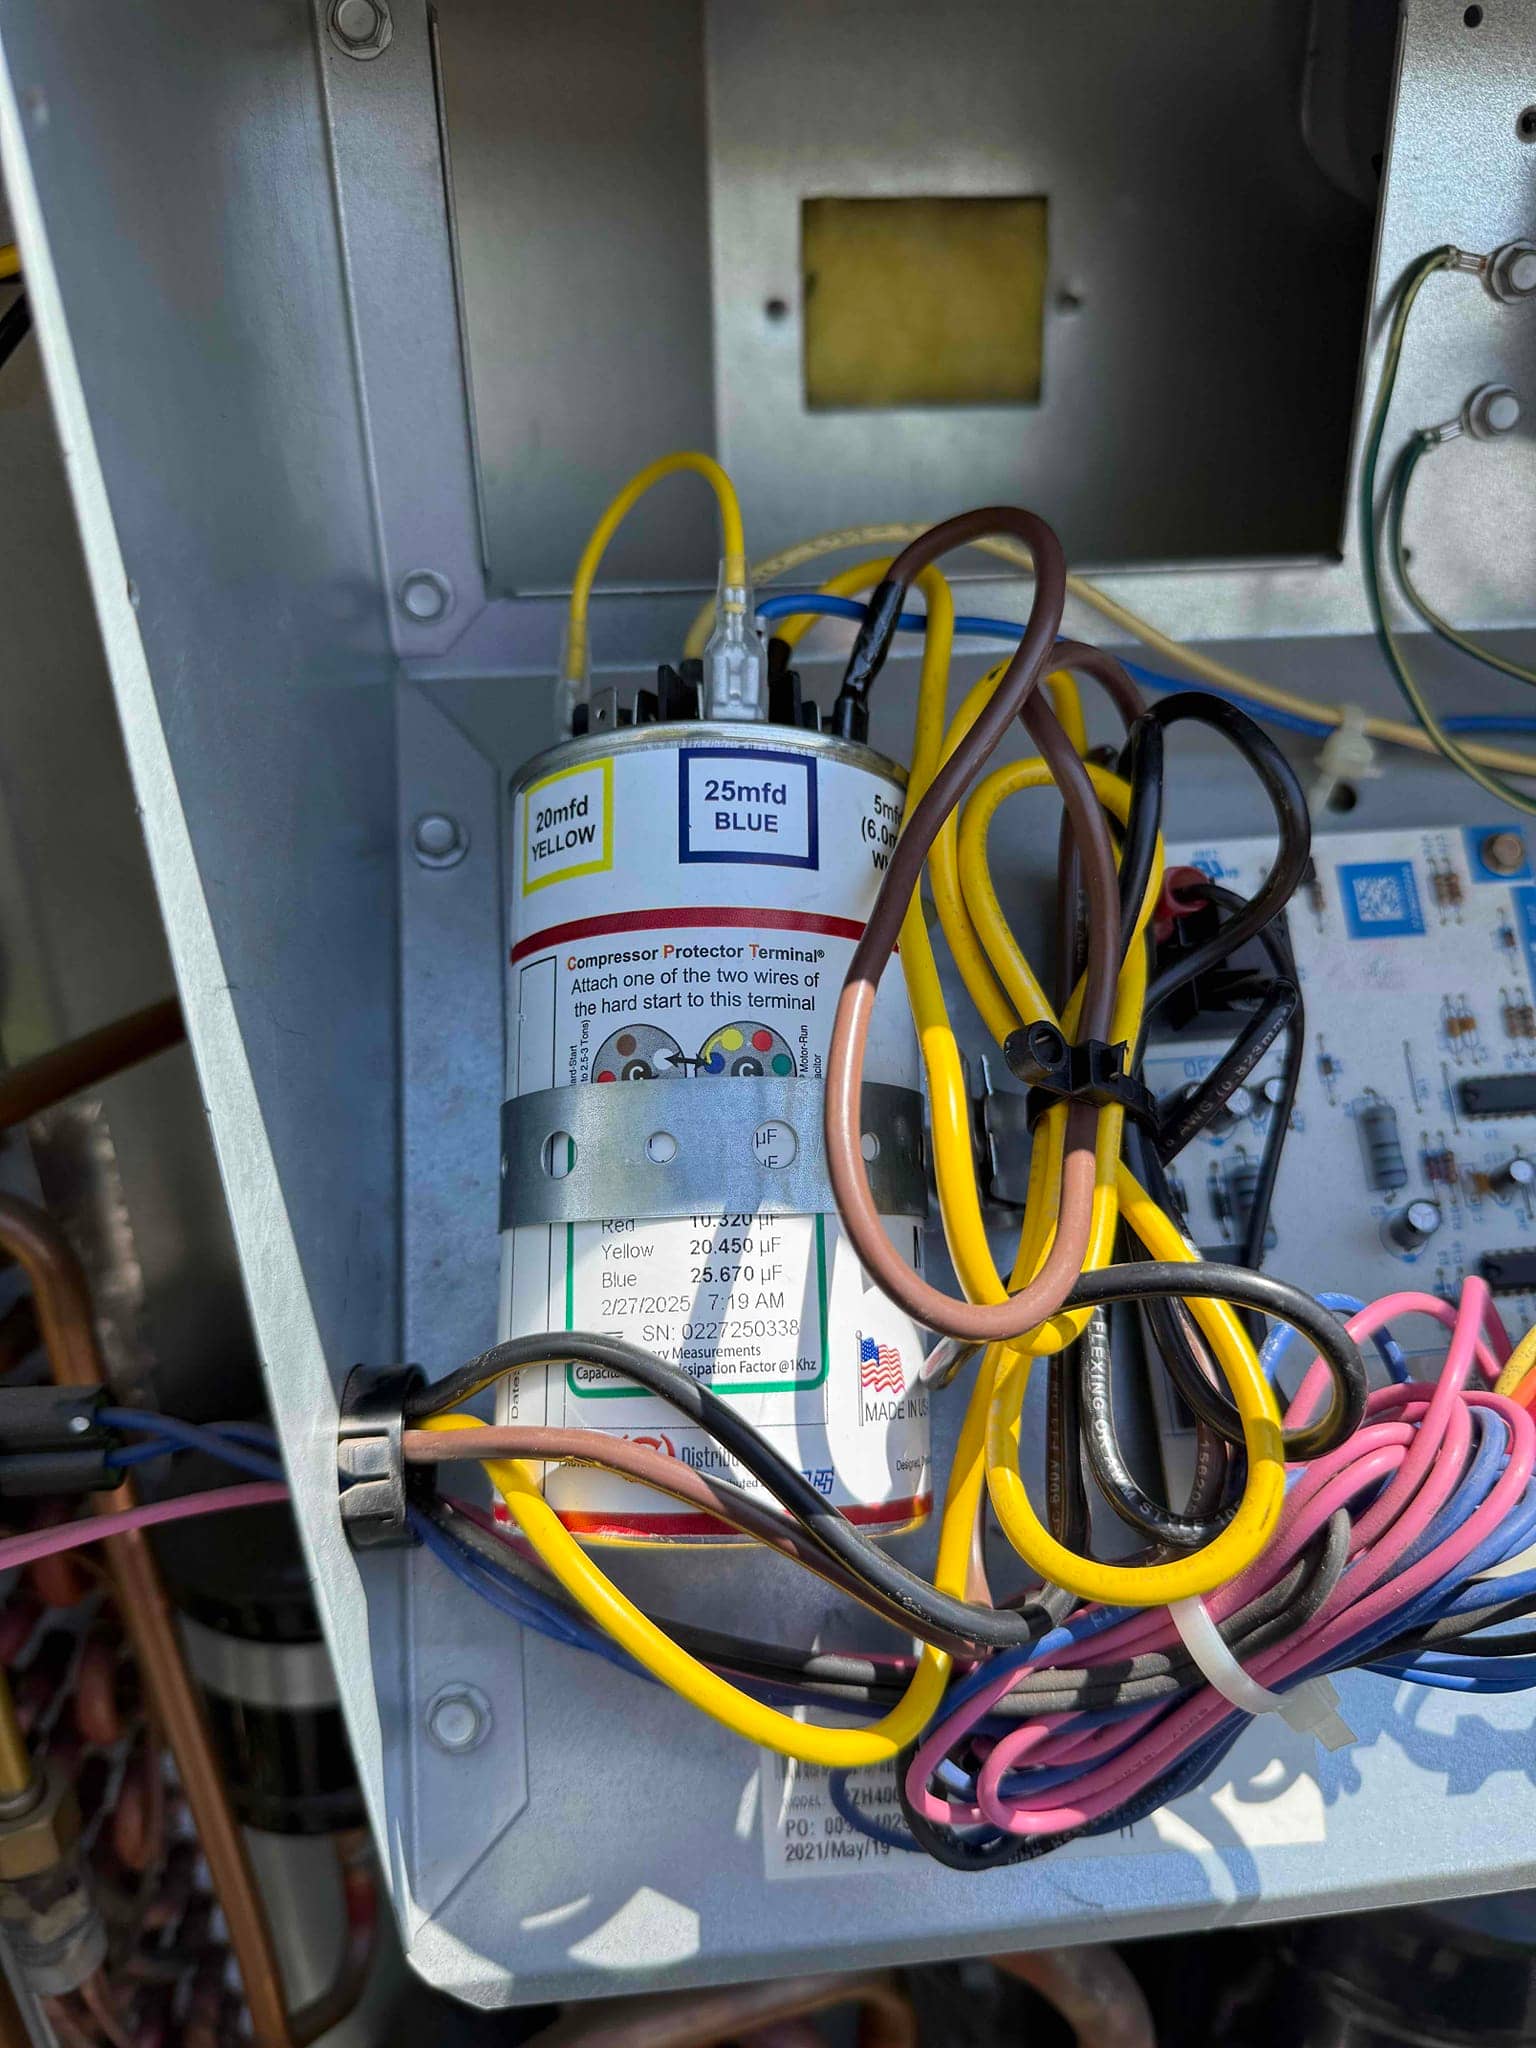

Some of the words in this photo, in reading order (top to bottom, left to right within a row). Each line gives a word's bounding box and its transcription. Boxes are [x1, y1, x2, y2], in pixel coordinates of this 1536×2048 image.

[704, 779, 787, 805] 25mfd
[536, 794, 588, 833] 20mfd
[715, 812, 779, 833] BLUE
[532, 824, 596, 862] YELLOW
[567, 948, 659, 971] Compressor
[663, 944, 744, 959] Protector
[571, 974, 618, 995] Attach
[623, 973, 655, 987] one
[661, 967, 678, 984] of
[683, 967, 711, 983] the
[717, 967, 748, 983] two
[754, 968, 799, 986] wires
[804, 972, 820, 988] of
[574, 1001, 597, 1017] the
[601, 995, 637, 1014] hard
[643, 993, 682, 1010] start
[687, 992, 704, 1007] to
[710, 991, 742, 1007] this
[747, 992, 815, 1011] terminal
[581, 1019, 591, 1044] Tons)
[800, 1024, 808, 1073] Motor-Run
[814, 1054, 822, 1079] acitor
[601, 1242, 655, 1260] Yellow
[689, 1238, 753, 1255] 20.450
[760, 1236, 782, 1257] µF
[602, 1271, 637, 1289] Blue
[690, 1265, 754, 1283] 25.670
[761, 1264, 783, 1286] µF
[601, 1295, 691, 1316] 2/27/2025
[708, 1292, 749, 1311] 7:19
[755, 1291, 785, 1310] AM
[642, 1324, 675, 1342] SN:
[682, 1318, 800, 1341] 0227250338
[672, 1344, 762, 1360] Measurements
[739, 1360, 776, 1373] Factor
[778, 1357, 817, 1374] @1Khz
[1090, 1320, 1107, 1411] FLEXING
[865, 1401, 904, 1422] MADE
[907, 1399, 917, 1418] IN
[785, 1818, 815, 1838] PO:
[785, 1838, 891, 1862] 2021/May/19
